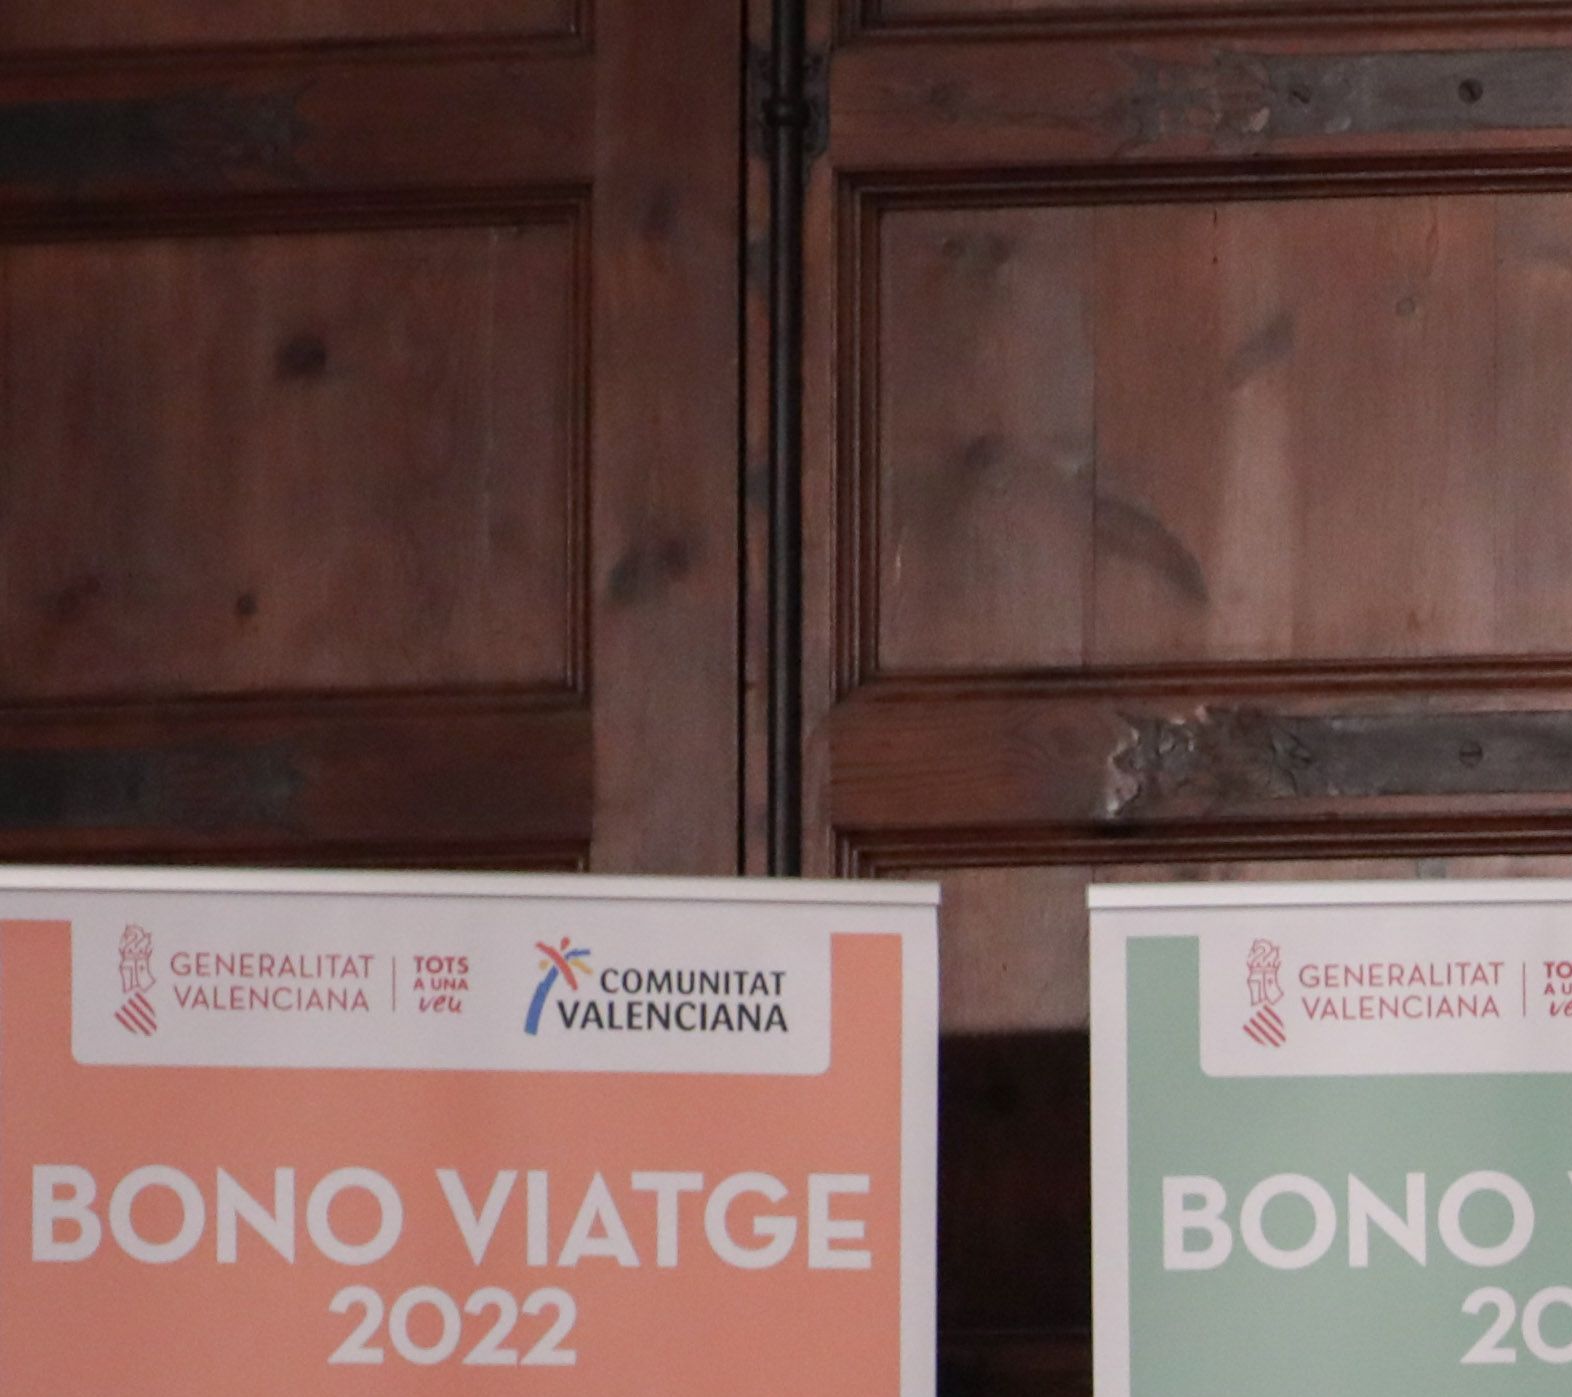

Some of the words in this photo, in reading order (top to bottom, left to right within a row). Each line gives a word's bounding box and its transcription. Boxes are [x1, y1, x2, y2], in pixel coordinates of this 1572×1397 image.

[170, 952, 373, 978] GENERALITAT
[415, 956, 469, 974] TOTS
[1298, 962, 1504, 988] GENERALITAT
[414, 978, 424, 989] A
[430, 978, 468, 990] UNA
[600, 969, 783, 995] COMUNITAT
[1544, 983, 1555, 994] A
[174, 985, 369, 1011] VALENCIANA
[419, 995, 461, 1013] veu
[1302, 995, 1499, 1019] VALENCIANA
[558, 1001, 787, 1032] VALENCIANA
[33, 1165, 403, 1265] BONO
[437, 1169, 871, 1269] VIATGE
[1163, 1171, 1534, 1269] BONO
[328, 1285, 577, 1365] 2022
